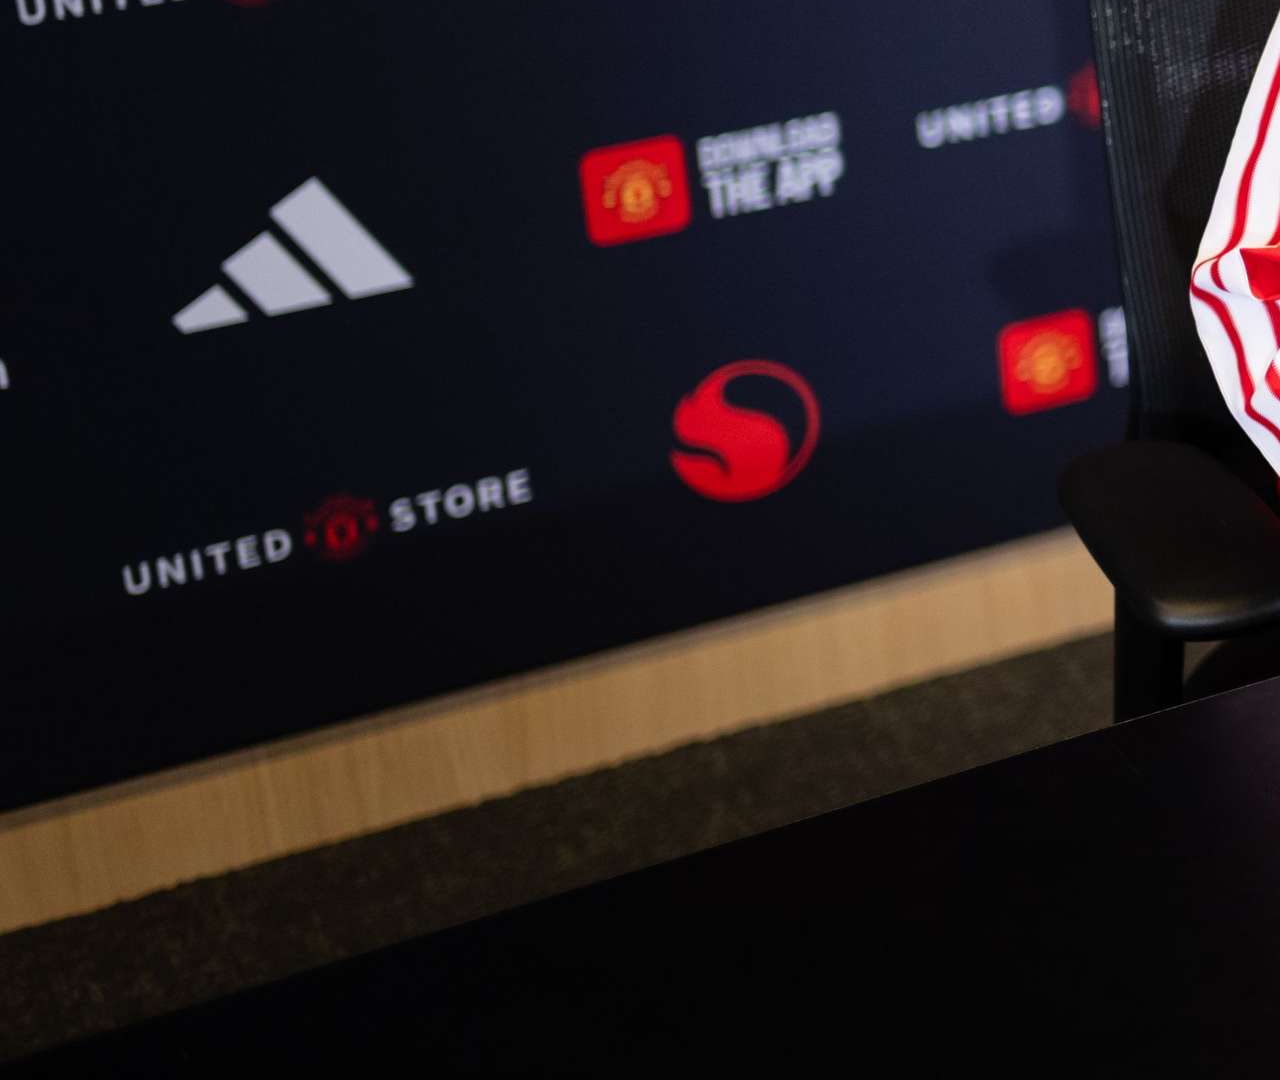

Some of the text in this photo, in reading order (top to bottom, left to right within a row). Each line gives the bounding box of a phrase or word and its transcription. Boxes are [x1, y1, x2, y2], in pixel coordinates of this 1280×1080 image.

[916, 86, 1065, 149] UNITED
[702, 160, 772, 219] THE
[122, 468, 532, 596] UNITED STORE
